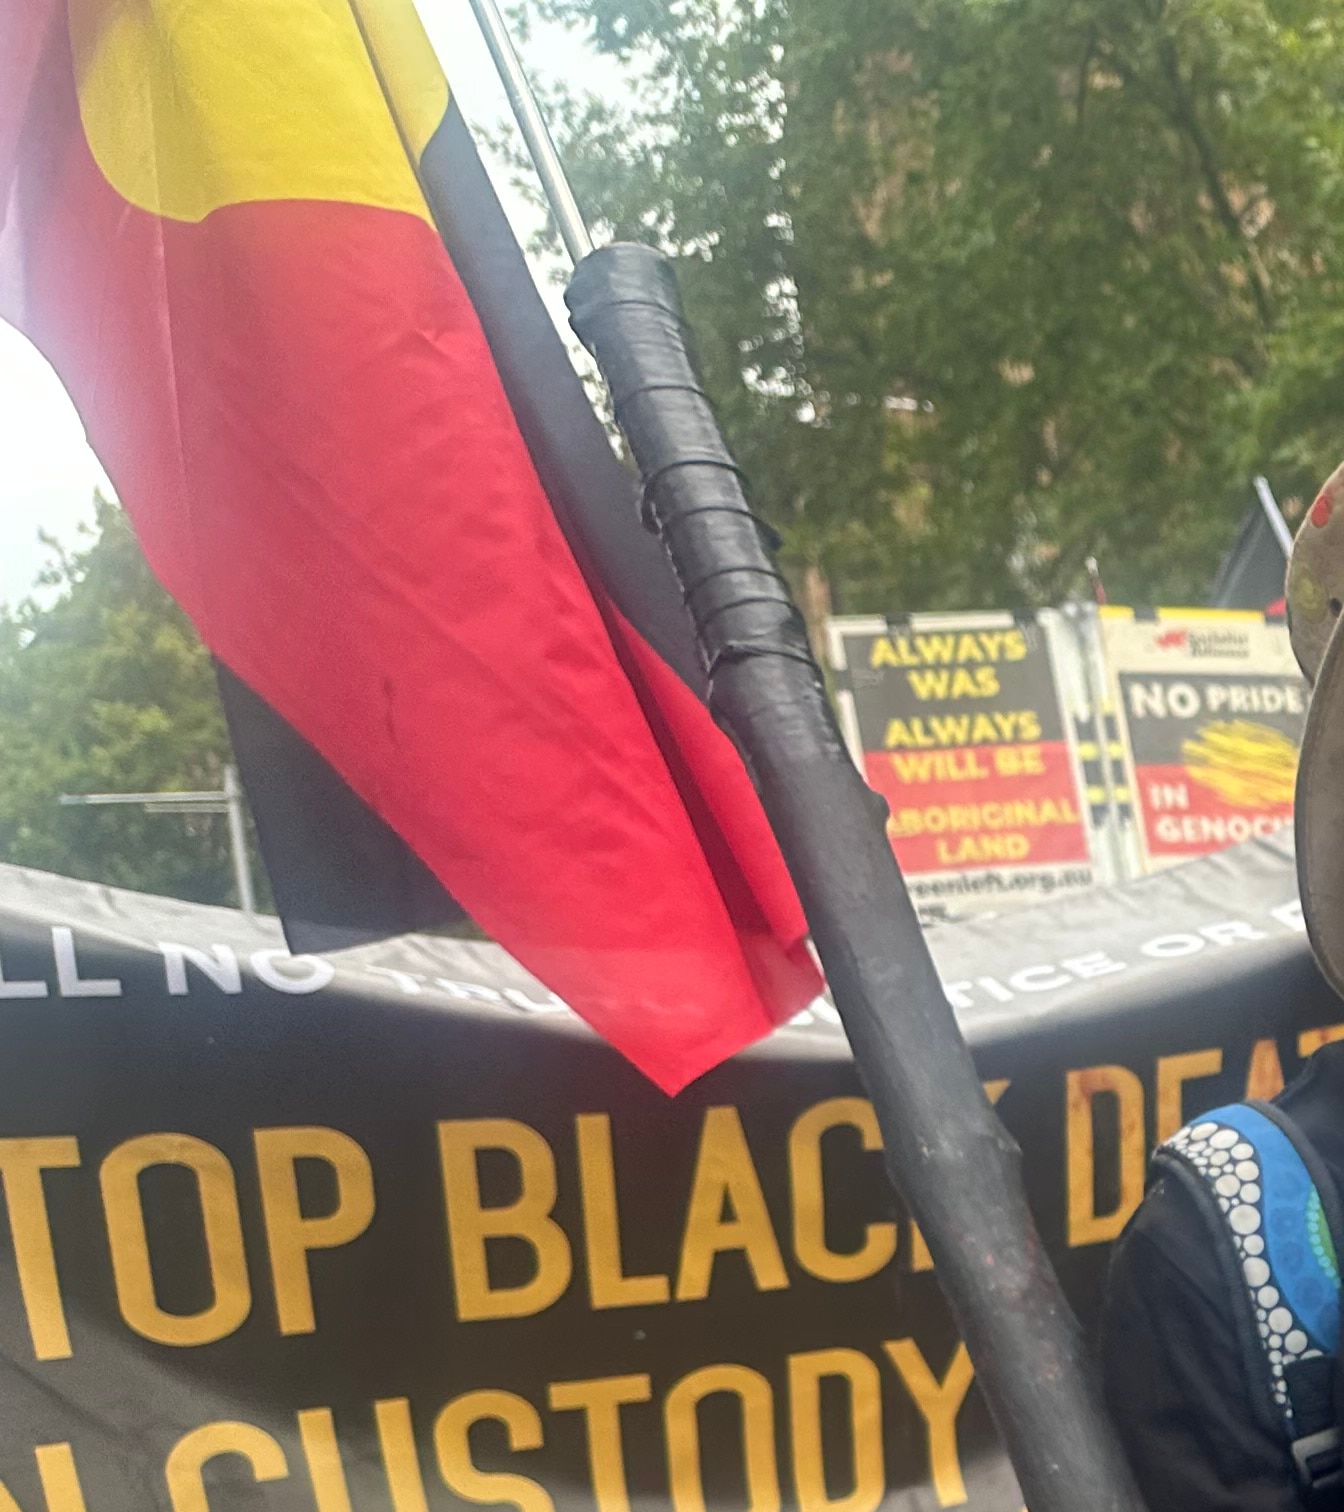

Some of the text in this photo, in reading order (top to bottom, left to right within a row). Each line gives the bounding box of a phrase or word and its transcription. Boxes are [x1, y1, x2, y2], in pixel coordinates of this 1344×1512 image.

[870, 630, 1027, 668] ALWAYS
[907, 666, 1000, 700] WAS
[1129, 683, 1199, 718] NO
[885, 710, 1042, 749] ALWAYS
[892, 745, 1046, 785] WILL BE
[1149, 784, 1189, 810] IN
[1156, 812, 1294, 842] GENOC
[936, 833, 1031, 864] LAND
[160, 943, 336, 996] NO
[1141, 920, 1267, 957] OR
[436, 1080, 1011, 1322] BLAC
